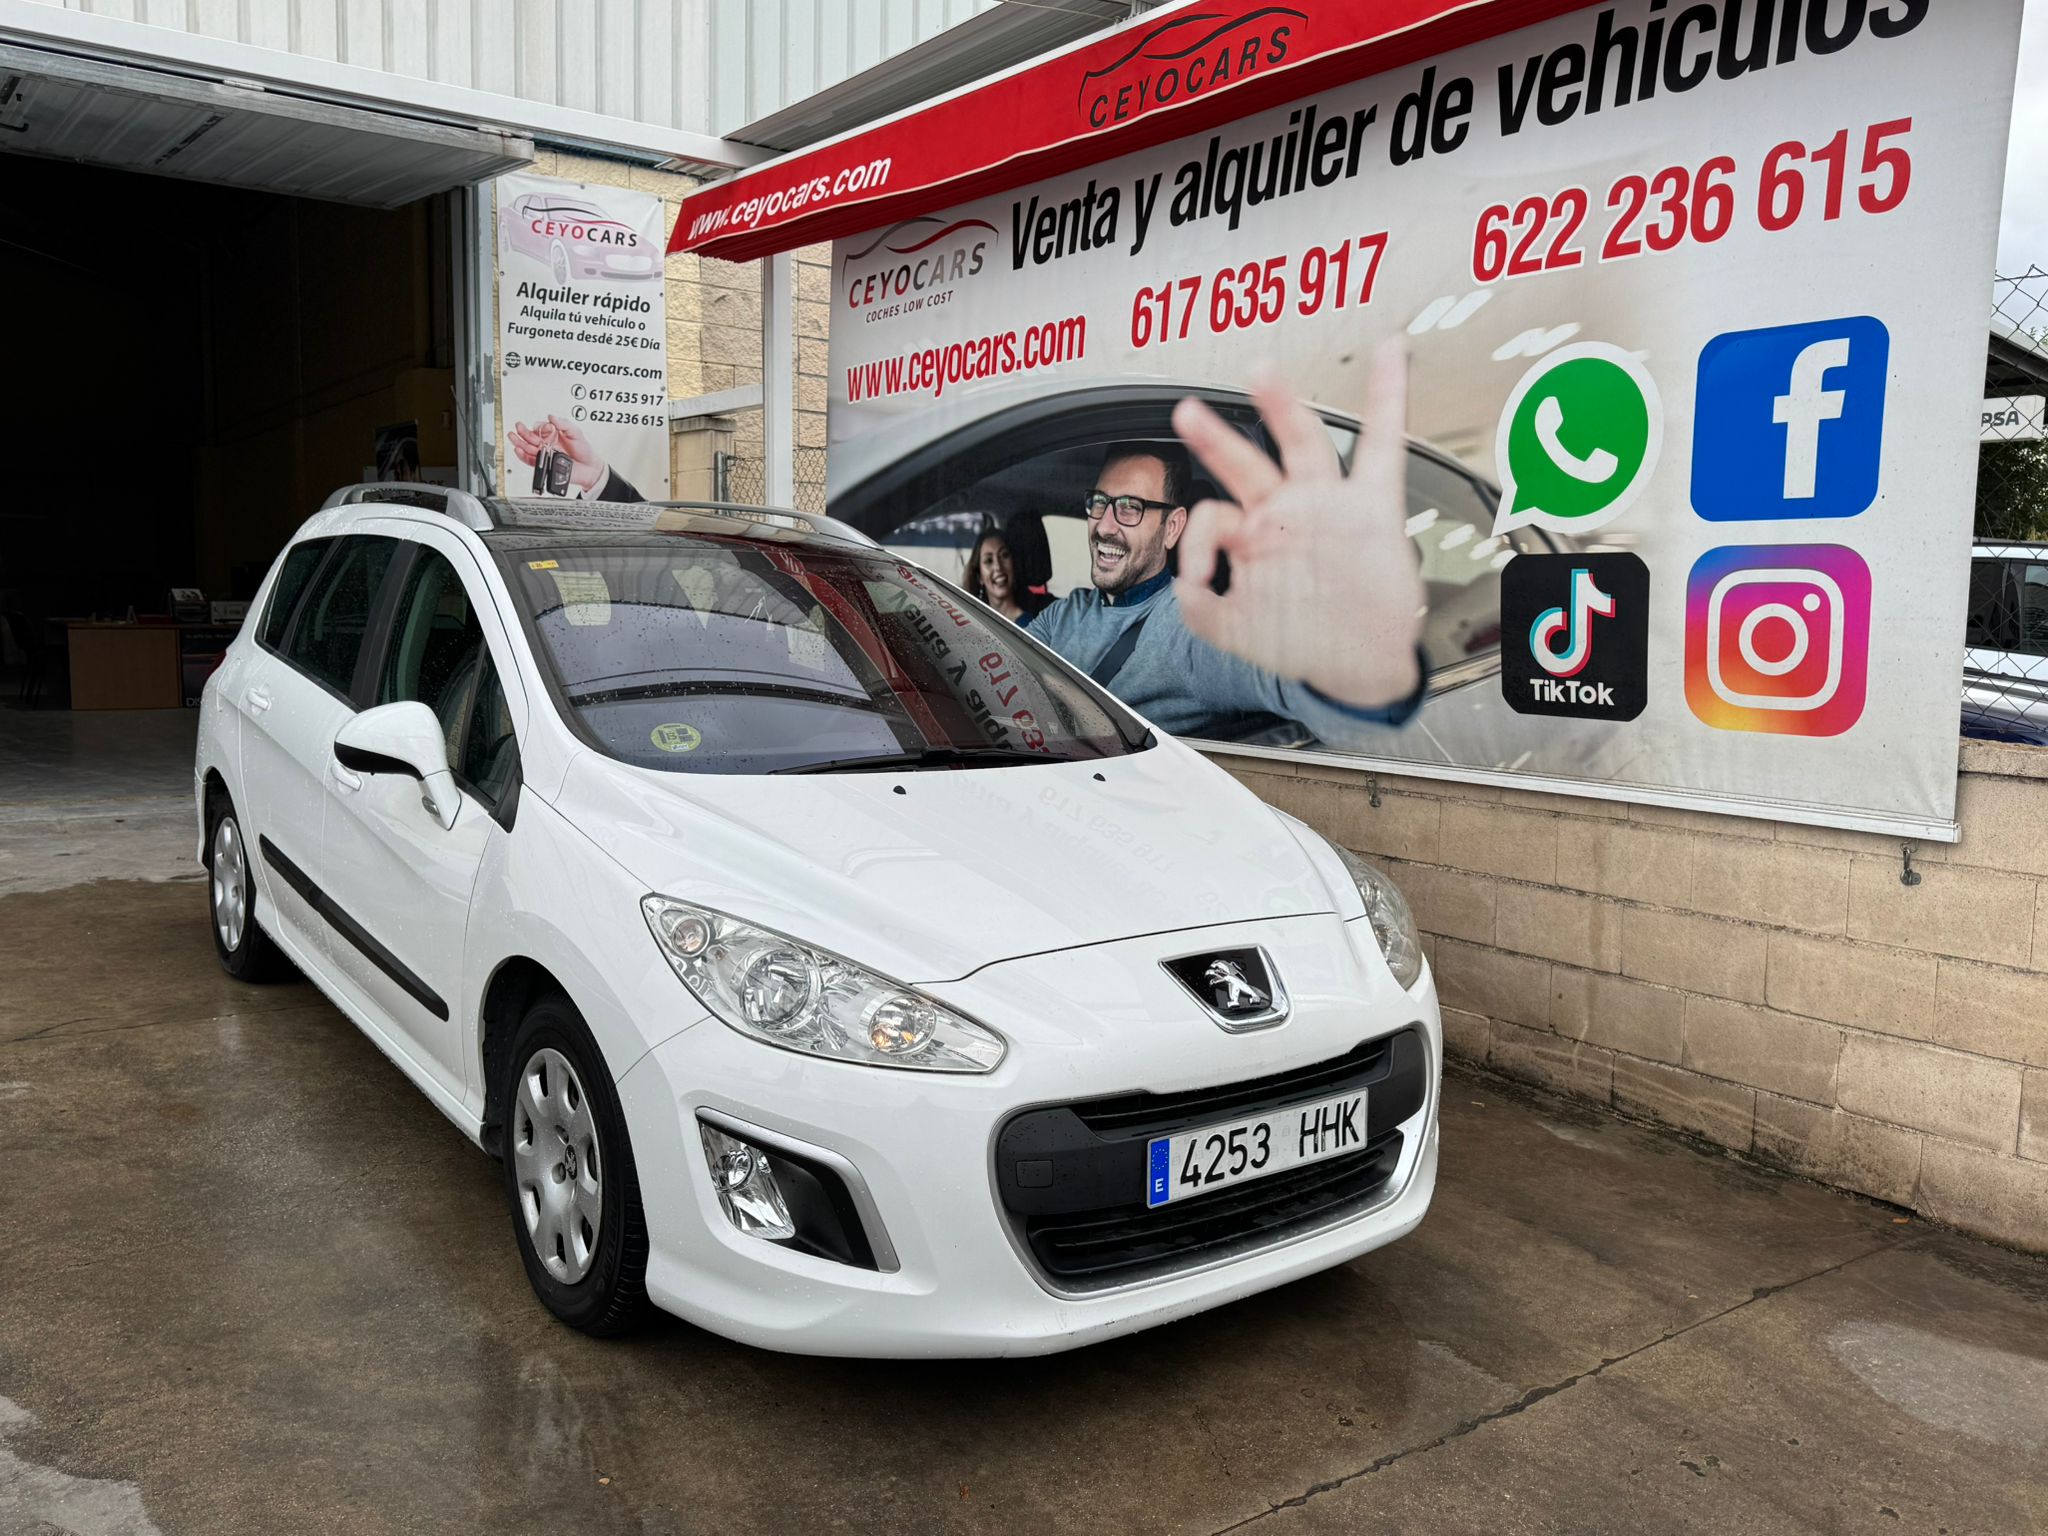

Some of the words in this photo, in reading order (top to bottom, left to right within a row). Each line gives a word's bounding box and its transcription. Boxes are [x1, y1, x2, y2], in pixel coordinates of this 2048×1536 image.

[1088, 26, 1291, 129] CEYOCARS
[1011, 179, 1121, 271] Venta
[1130, 172, 1162, 257] y
[1169, 103, 1378, 231] alquiler
[1389, 65, 1474, 166] de
[688, 155, 893, 241] www.ceyocars.com
[1474, 188, 1587, 283] 622
[1601, 156, 1736, 260] 236
[1757, 117, 1913, 233] 615
[531, 219, 638, 247] CEYOCARS
[848, 241, 986, 309] CEYOCARS
[1131, 275, 1201, 349] 617
[1209, 255, 1287, 333] 635
[1298, 231, 1389, 316] 917
[516, 281, 589, 305] Alquiler
[593, 292, 651, 313] rápido
[865, 303, 898, 324] COCHES
[902, 298, 924, 314] LOW
[926, 290, 953, 310] COST
[520, 305, 566, 322] Alquila
[569, 312, 582, 323] tú
[584, 314, 636, 330] vehículo
[638, 321, 646, 331] o
[507, 322, 574, 341] Furgoneta
[576, 329, 613, 345] desdé
[615, 335, 639, 348] 25€
[640, 337, 661, 350] Día
[524, 355, 663, 380] www.ceyocars.com
[847, 314, 1086, 403] www.ceyocars.com
[589, 389, 613, 401] 617
[615, 391, 638, 404] 635
[640, 393, 663, 406] 917
[590, 410, 613, 423] 622
[616, 412, 639, 425] 236
[641, 414, 664, 427] 615
[1529, 678, 1615, 706] TikTok
[1179, 1122, 1271, 1189] 4253
[1299, 1097, 1361, 1158] HHK
[1154, 1178, 1164, 1193] E
